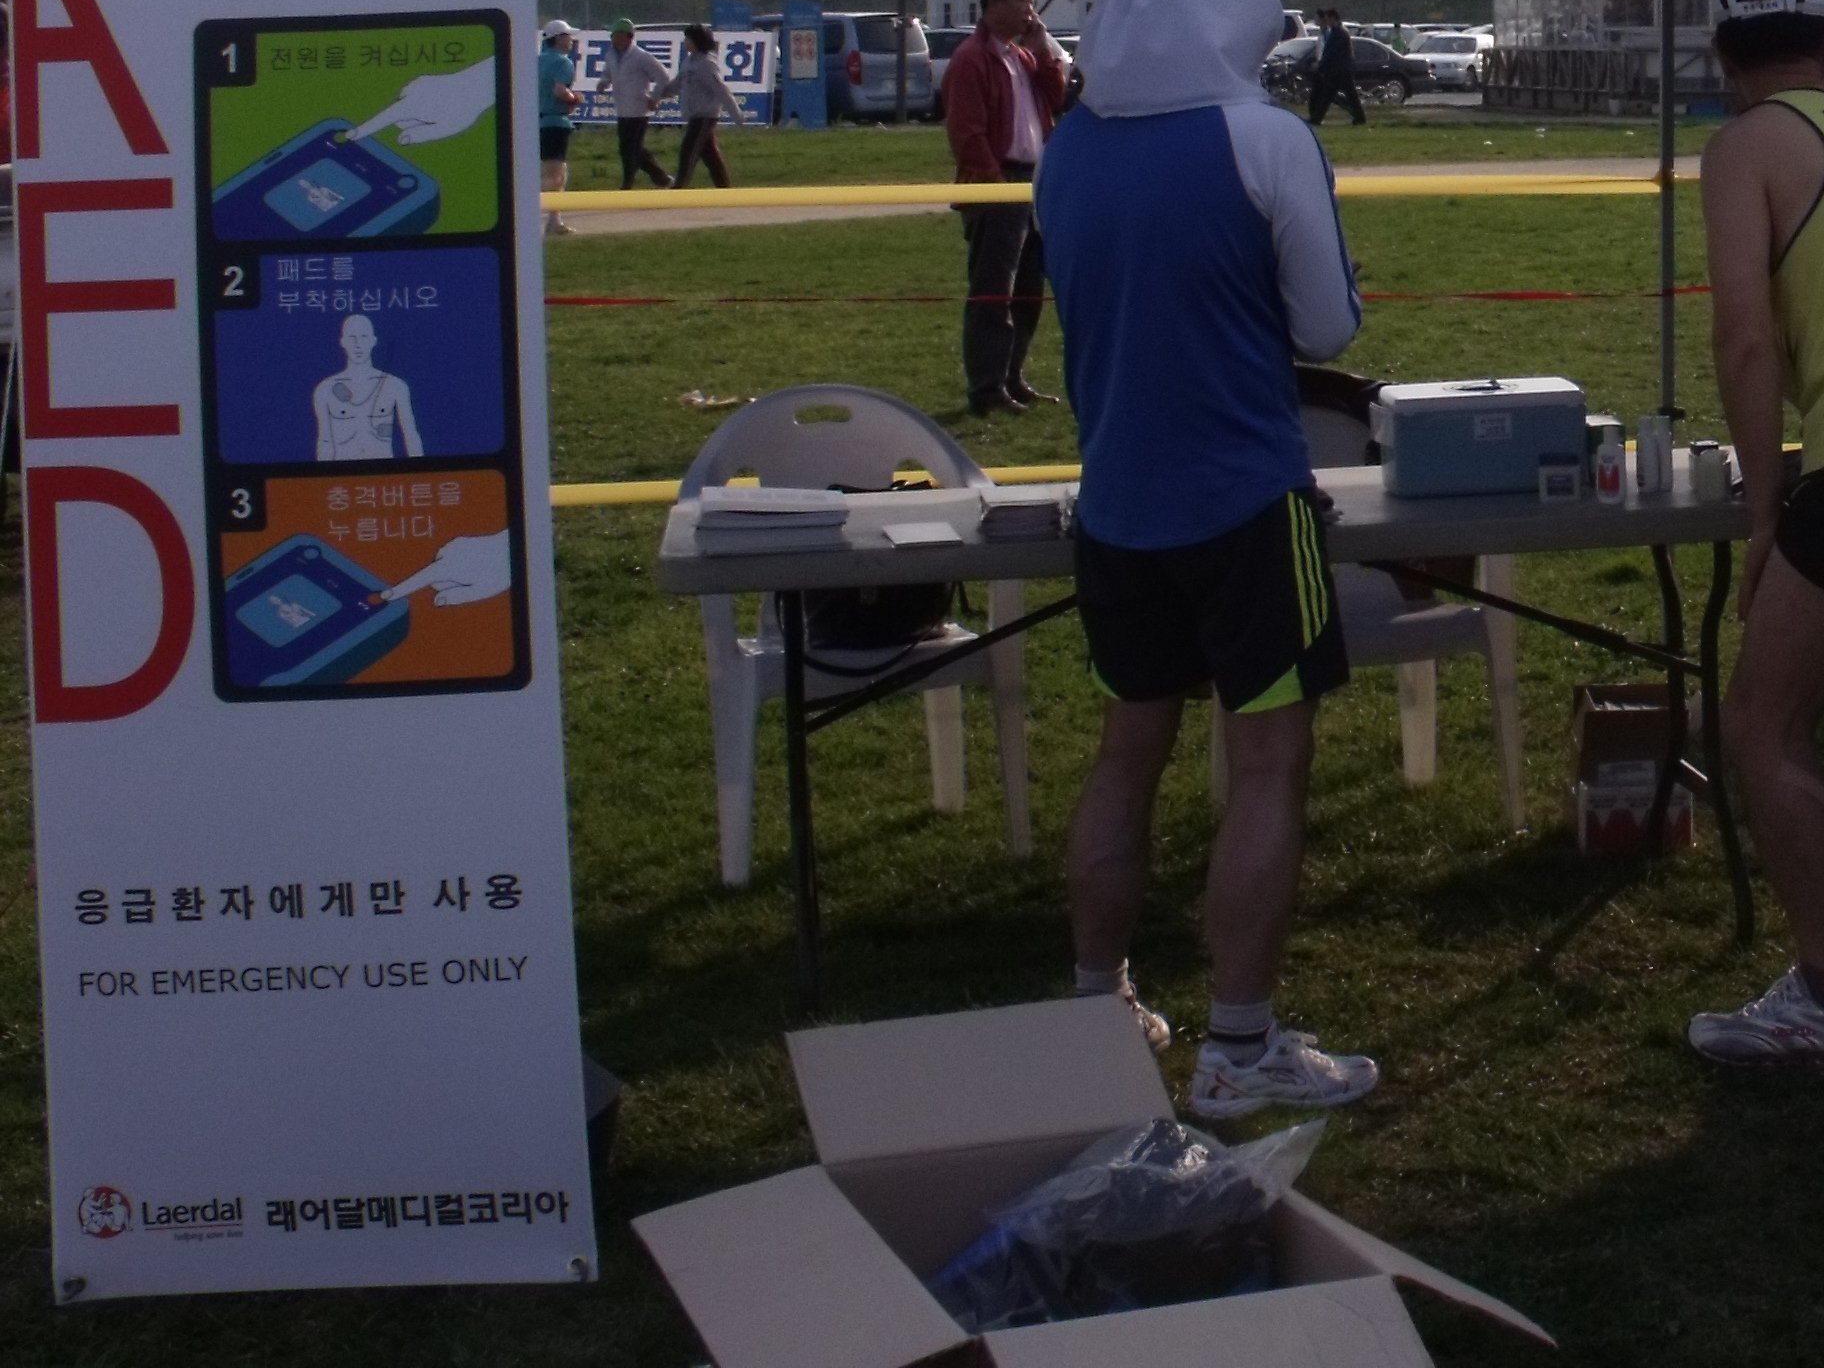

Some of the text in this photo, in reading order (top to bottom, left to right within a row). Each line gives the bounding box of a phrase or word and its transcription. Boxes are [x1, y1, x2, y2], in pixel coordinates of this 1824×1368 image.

[221, 43, 238, 74] 1
[270, 40, 467, 71] 전원을 켜십시오
[223, 266, 245, 297] 2
[277, 257, 354, 282] 패드를
[277, 285, 439, 314] 부착하십시오
[231, 488, 253, 519] 3
[326, 480, 462, 512] 충격버튼을
[326, 515, 437, 543] 누릅니다
[74, 873, 524, 926] 응급환자에게만 사용
[80, 956, 529, 997] FOR EMERGENCY USE ONLY
[142, 1197, 243, 1225] Laerdal
[265, 1190, 570, 1232] 래어달메디컬코리아
